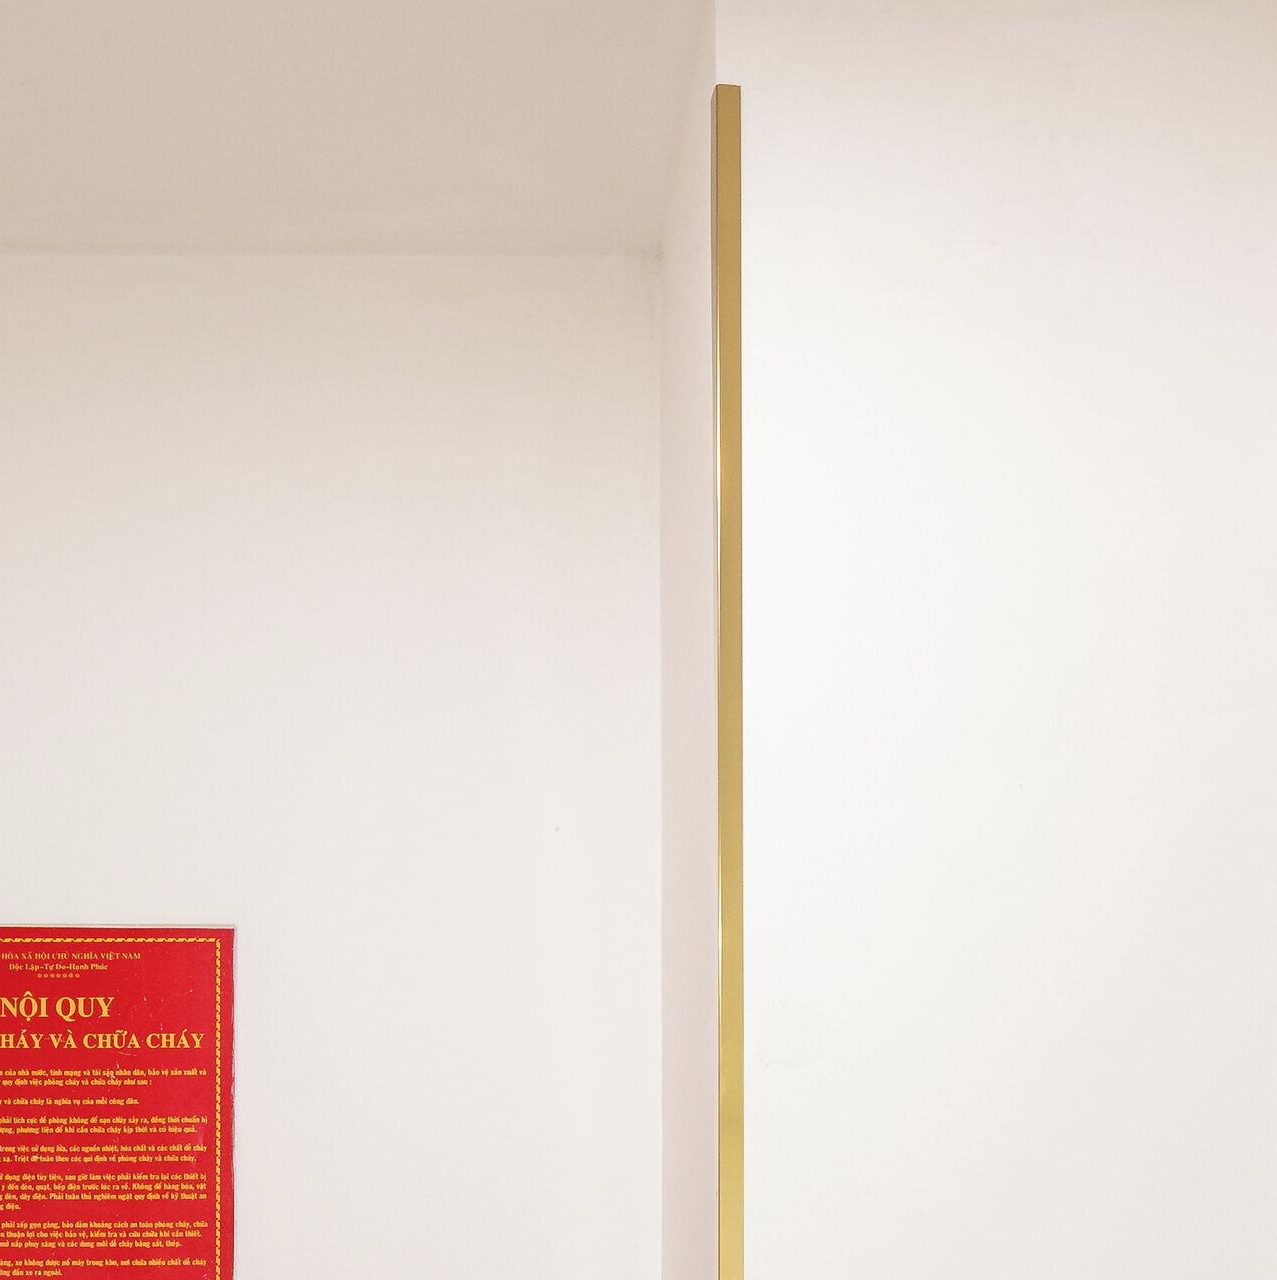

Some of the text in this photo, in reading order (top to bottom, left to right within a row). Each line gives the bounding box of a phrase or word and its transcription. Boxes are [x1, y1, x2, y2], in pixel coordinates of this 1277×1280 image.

[0, 991, 114, 1022] NỘI QUY
[49, 1029, 77, 1049] VÀ
[83, 1030, 141, 1049] CHỮA
[146, 1028, 204, 1049] CHÁY
